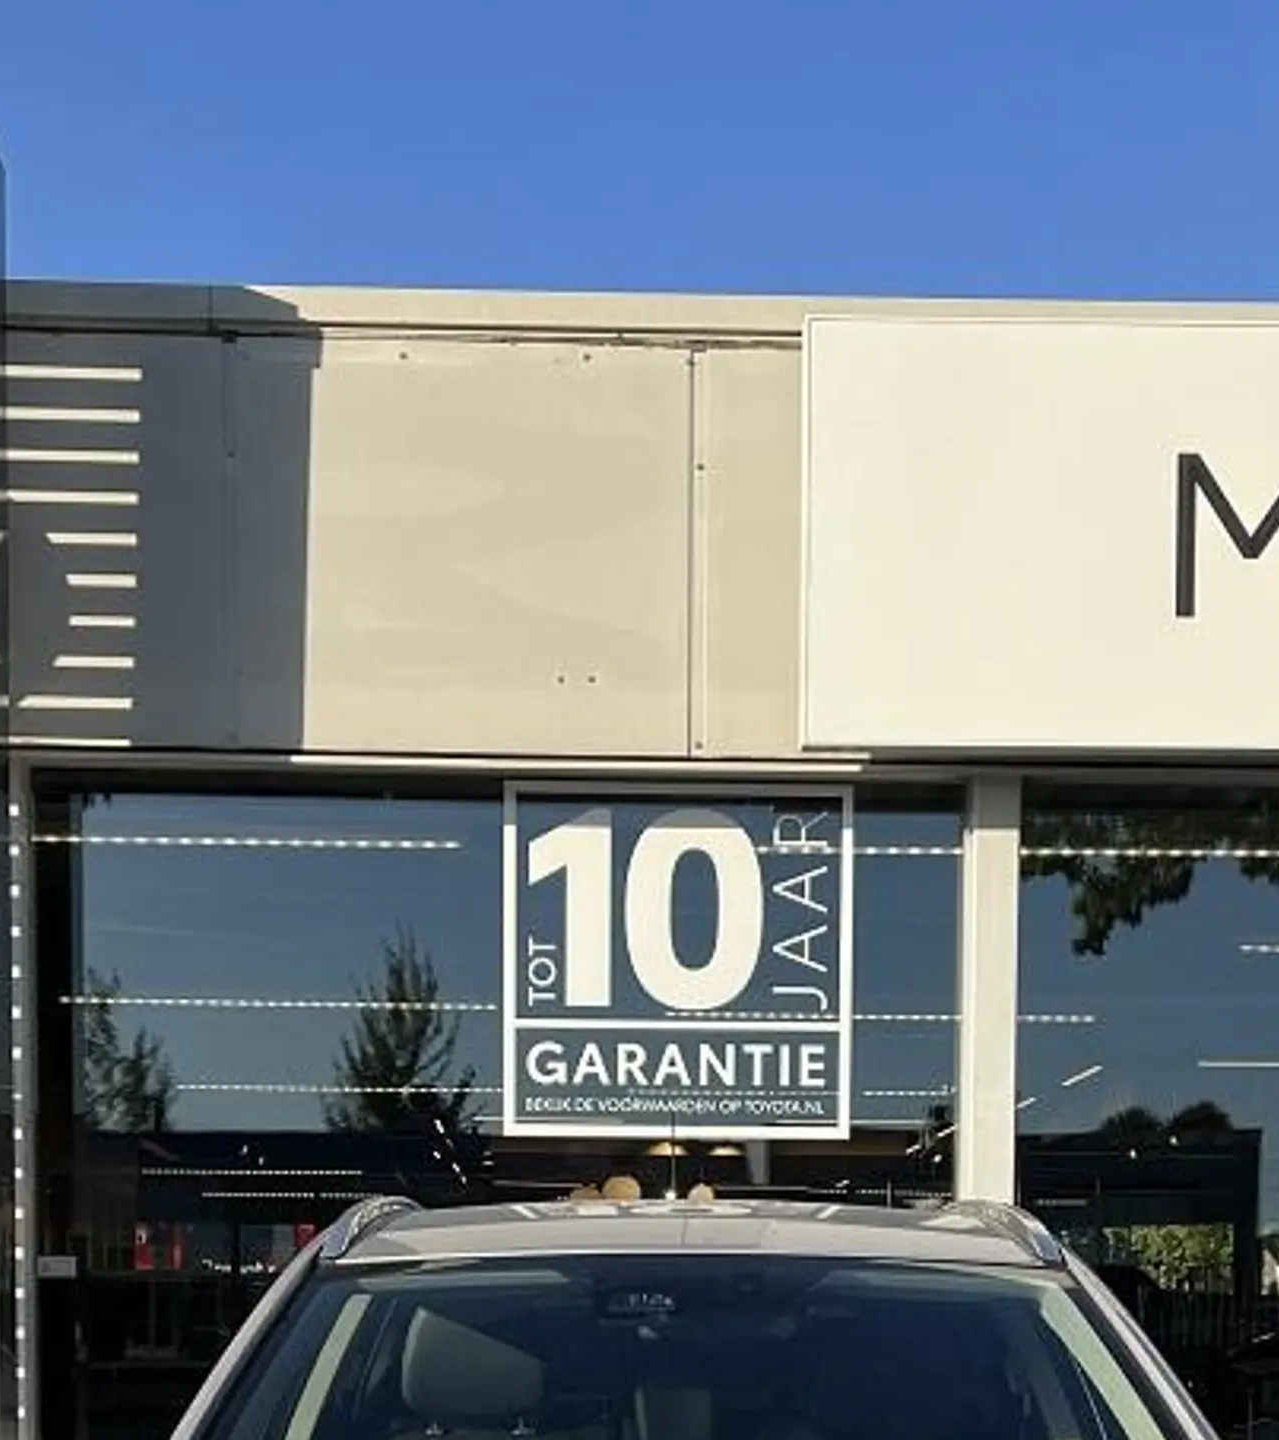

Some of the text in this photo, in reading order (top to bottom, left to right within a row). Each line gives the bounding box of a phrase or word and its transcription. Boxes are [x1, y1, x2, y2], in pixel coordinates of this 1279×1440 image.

[527, 807, 765, 1011] 10
[772, 811, 829, 1011] JAAR
[527, 935, 558, 1007] TOT
[526, 1040, 826, 1088] GARANTIE
[573, 1097, 593, 1112] DE
[597, 1098, 716, 1114] VOORWAARDEN
[719, 1099, 742, 1115] OP
